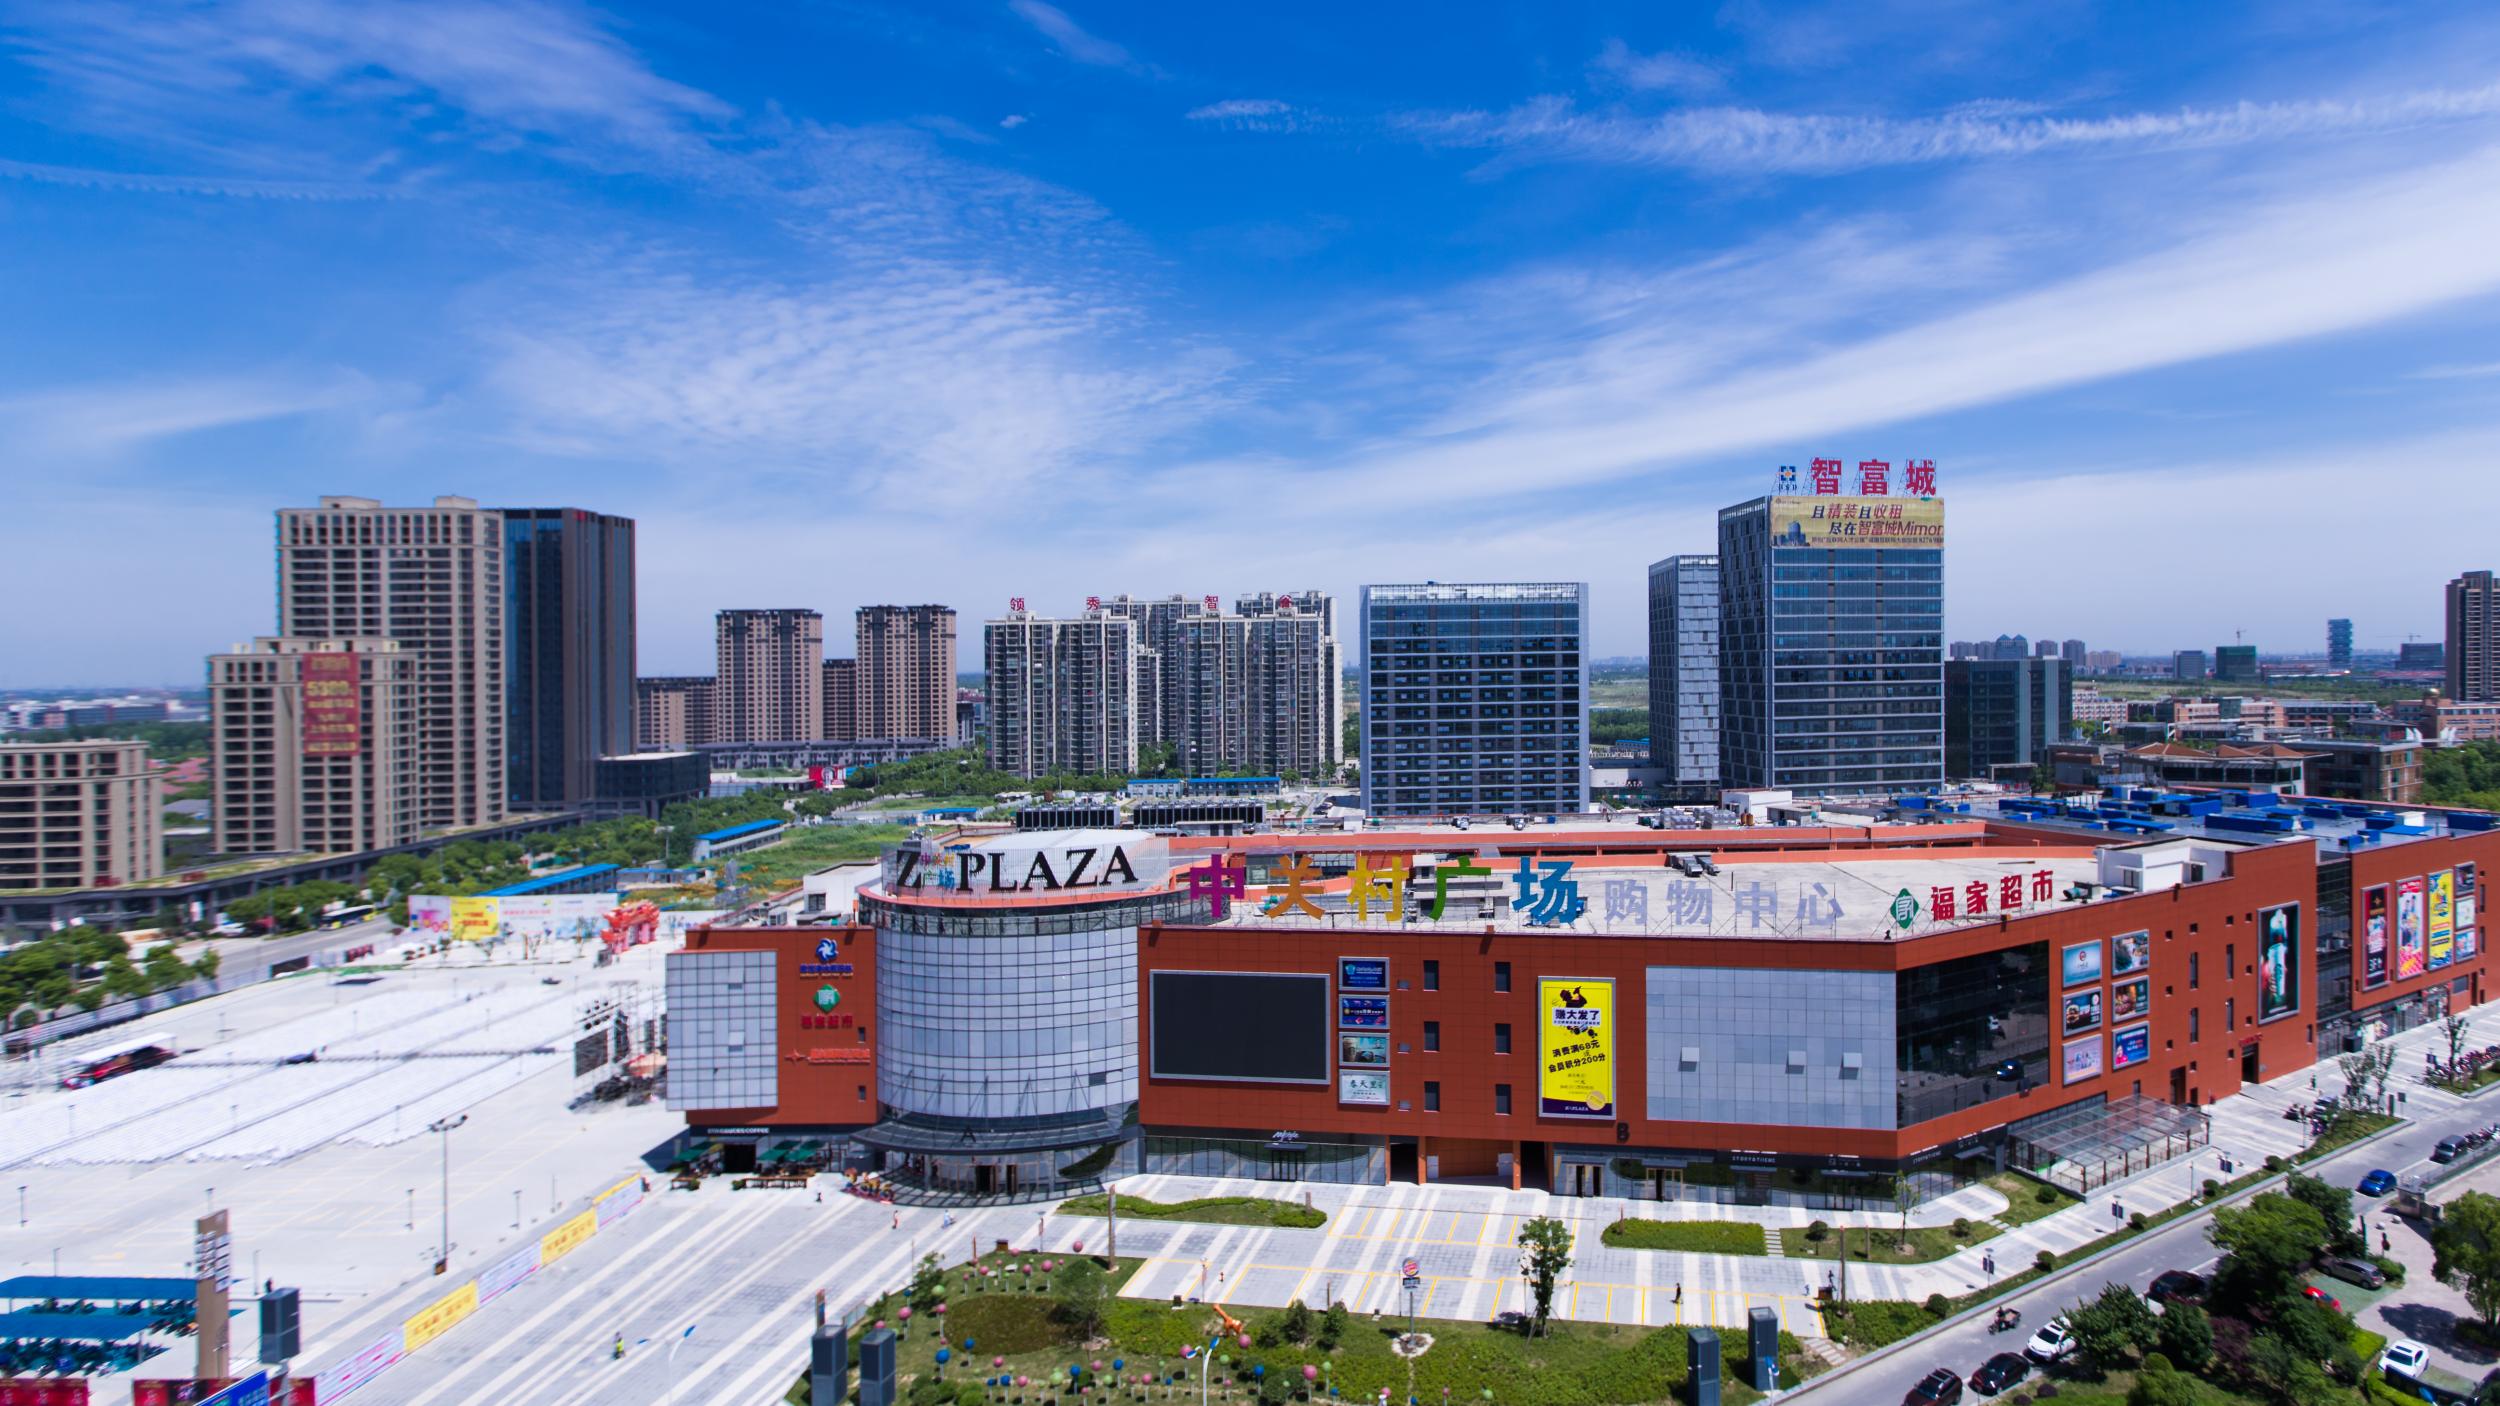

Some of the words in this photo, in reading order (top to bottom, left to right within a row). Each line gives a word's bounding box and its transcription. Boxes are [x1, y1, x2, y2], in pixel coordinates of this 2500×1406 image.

[1811, 457, 1937, 496] 智富城
[1811, 503, 1904, 519] 且精装且收租
[1009, 594, 1293, 611] 领秀智谷
[896, 850, 922, 888] Z
[956, 845, 1139, 892] PLAZA
[1190, 853, 1579, 924] 中关村广场
[1604, 879, 1845, 928] 购物中心
[1930, 869, 2054, 922] 福家超市
[960, 1125, 977, 1143] A
[1616, 1122, 1630, 1142] B
